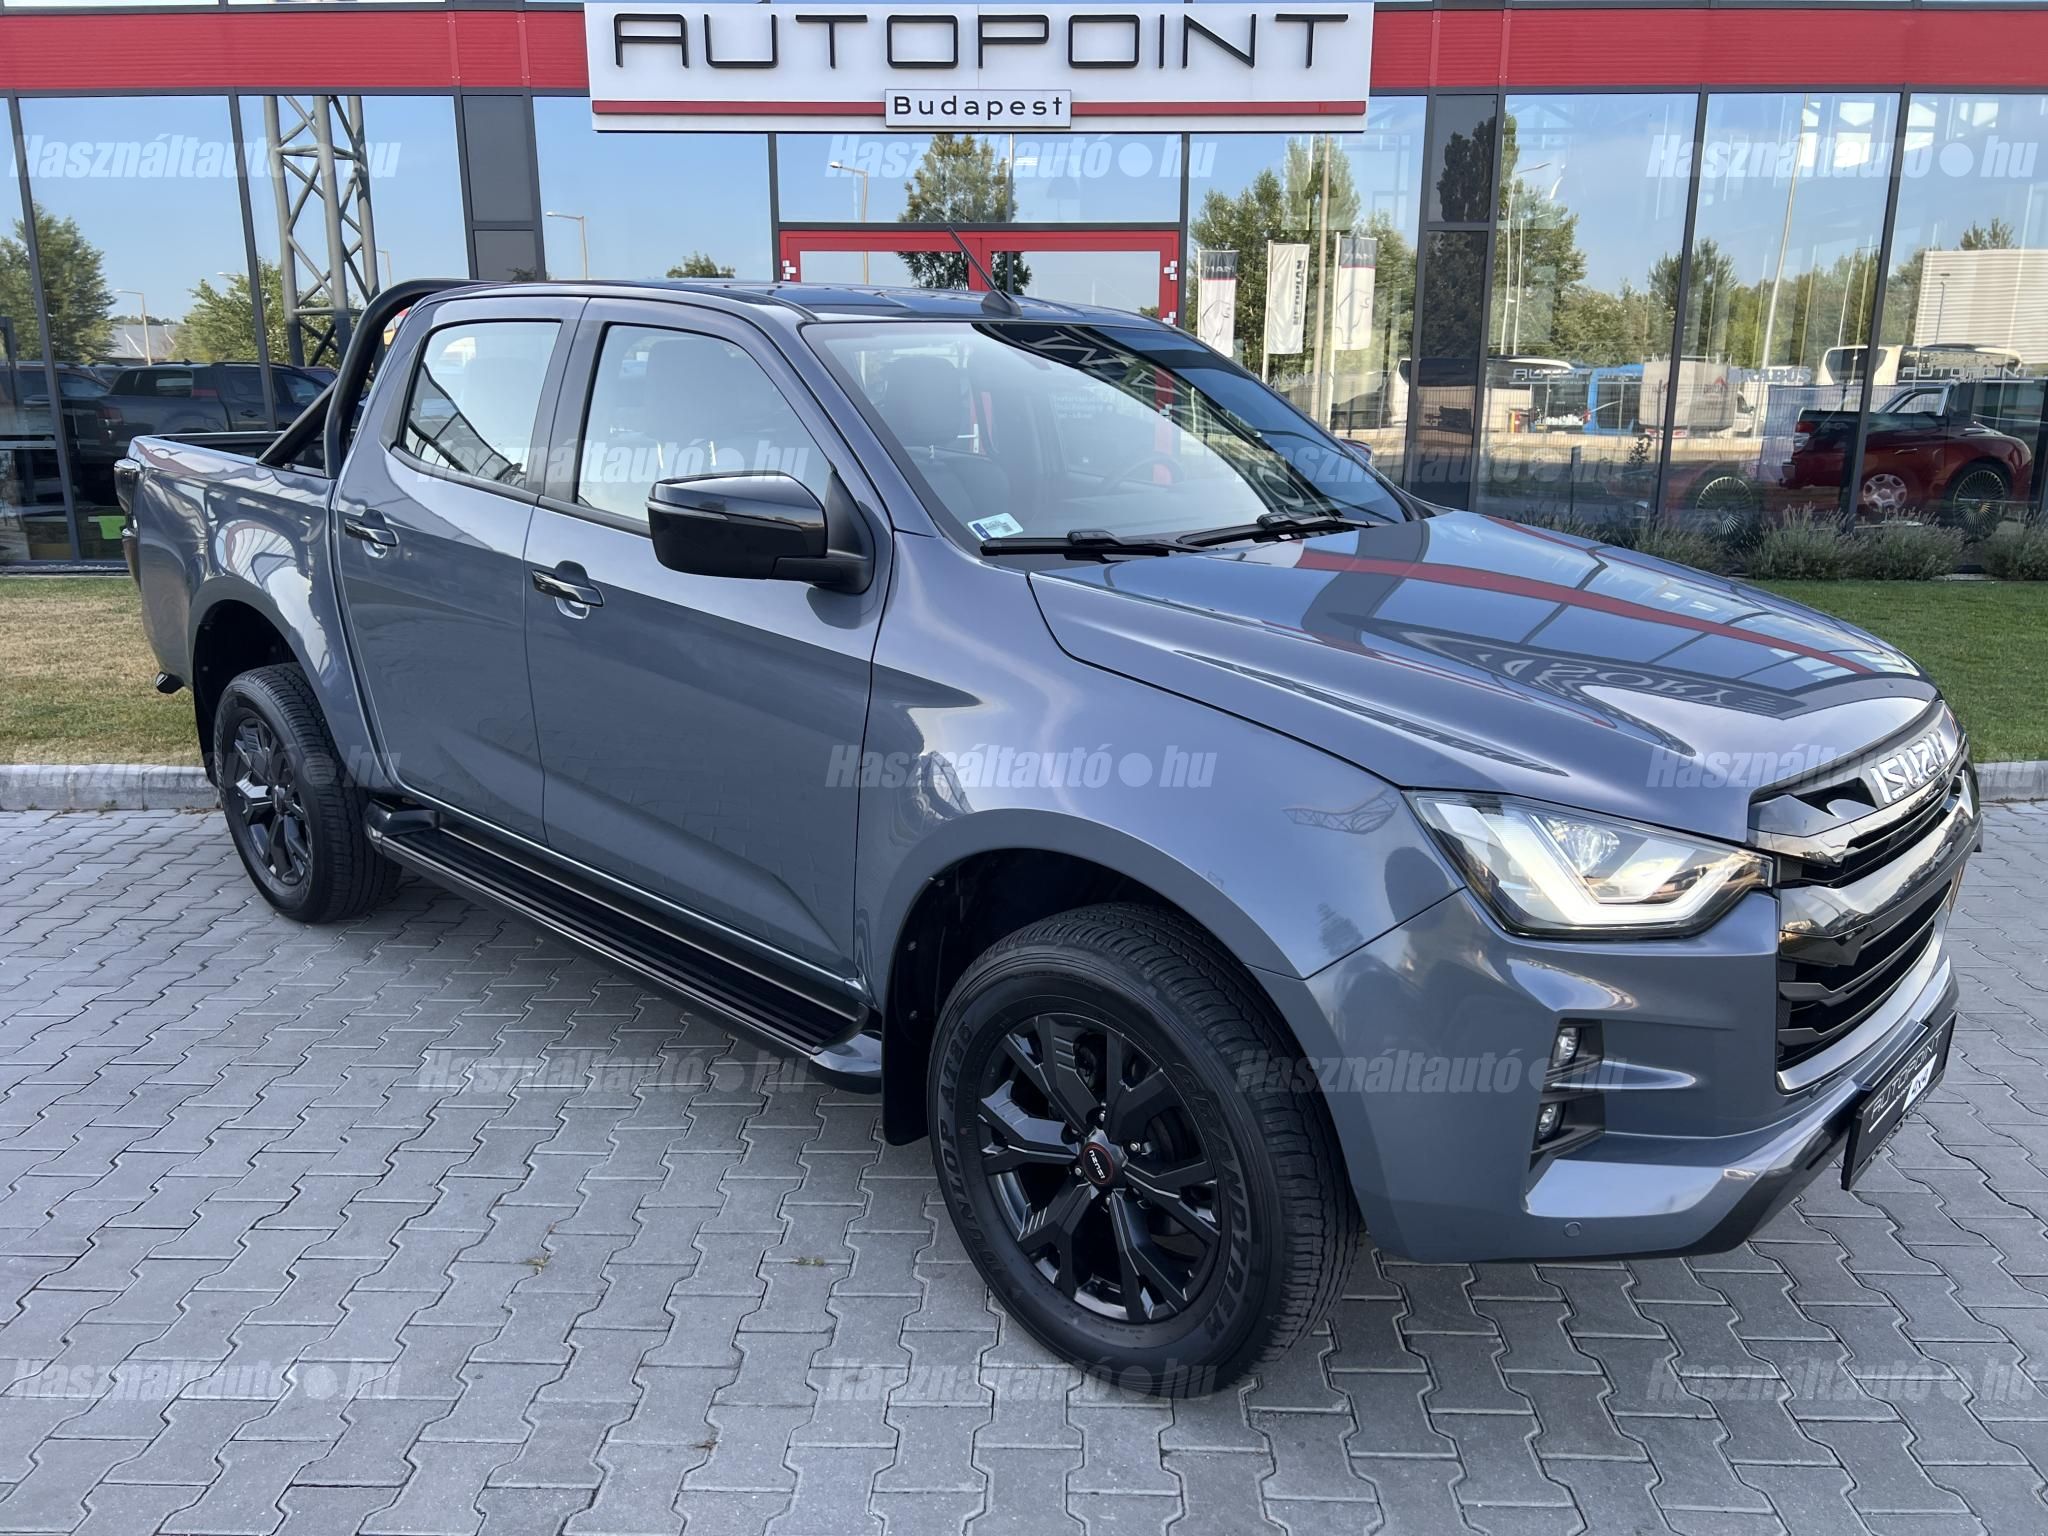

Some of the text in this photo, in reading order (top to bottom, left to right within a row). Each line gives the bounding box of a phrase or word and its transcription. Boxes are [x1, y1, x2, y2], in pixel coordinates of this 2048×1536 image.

[614, 13, 1348, 69] AUTOPOINT
[894, 95, 1063, 120] Budapest
[1869, 728, 1948, 804] ISUZU
[1871, 1031, 1943, 1120] AUTOPOINT
[1089, 1150, 1106, 1179] ISUZU
